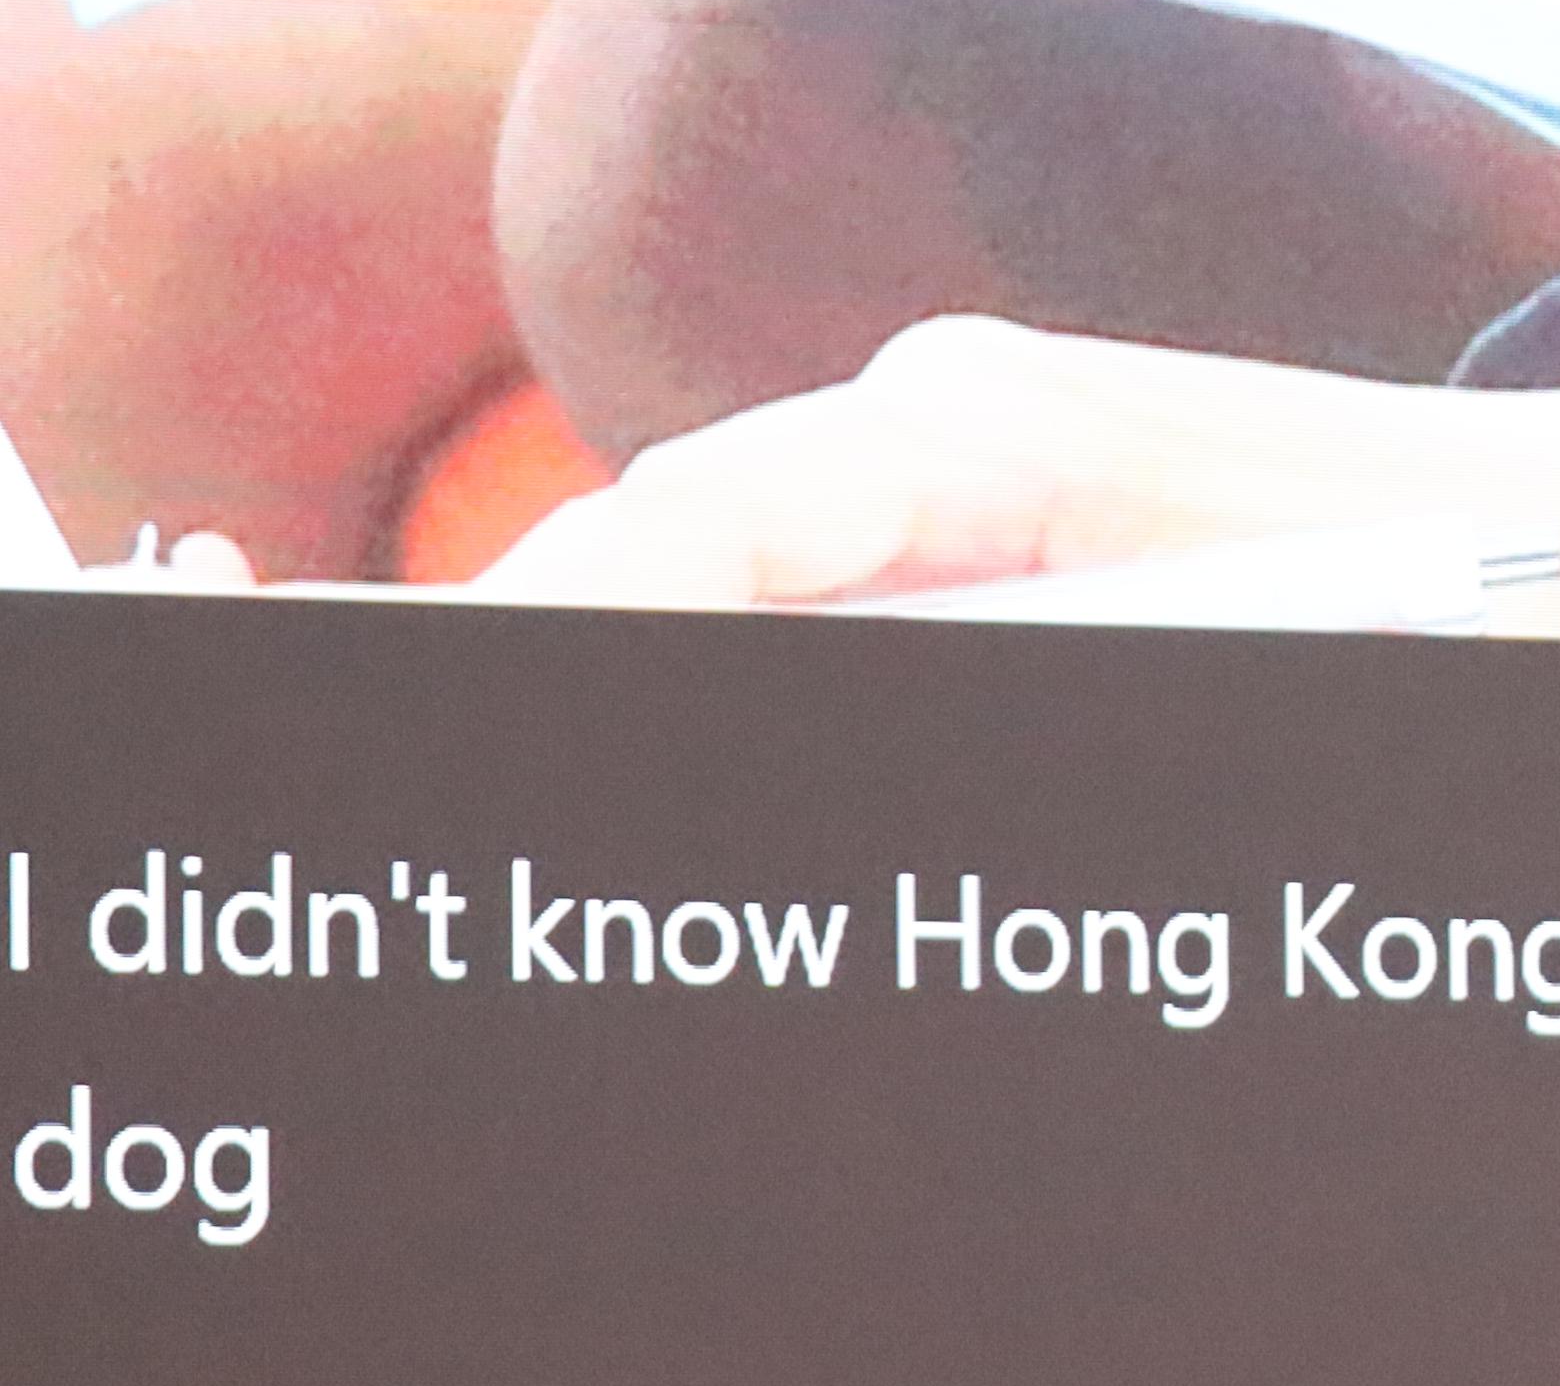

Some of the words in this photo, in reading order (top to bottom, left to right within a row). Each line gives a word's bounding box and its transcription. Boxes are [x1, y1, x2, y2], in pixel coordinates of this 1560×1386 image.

[8, 851, 31, 972] I
[88, 847, 468, 981] didn't
[510, 856, 851, 989] know
[895, 871, 1231, 1030] Hong
[13, 1083, 271, 1247] dog
